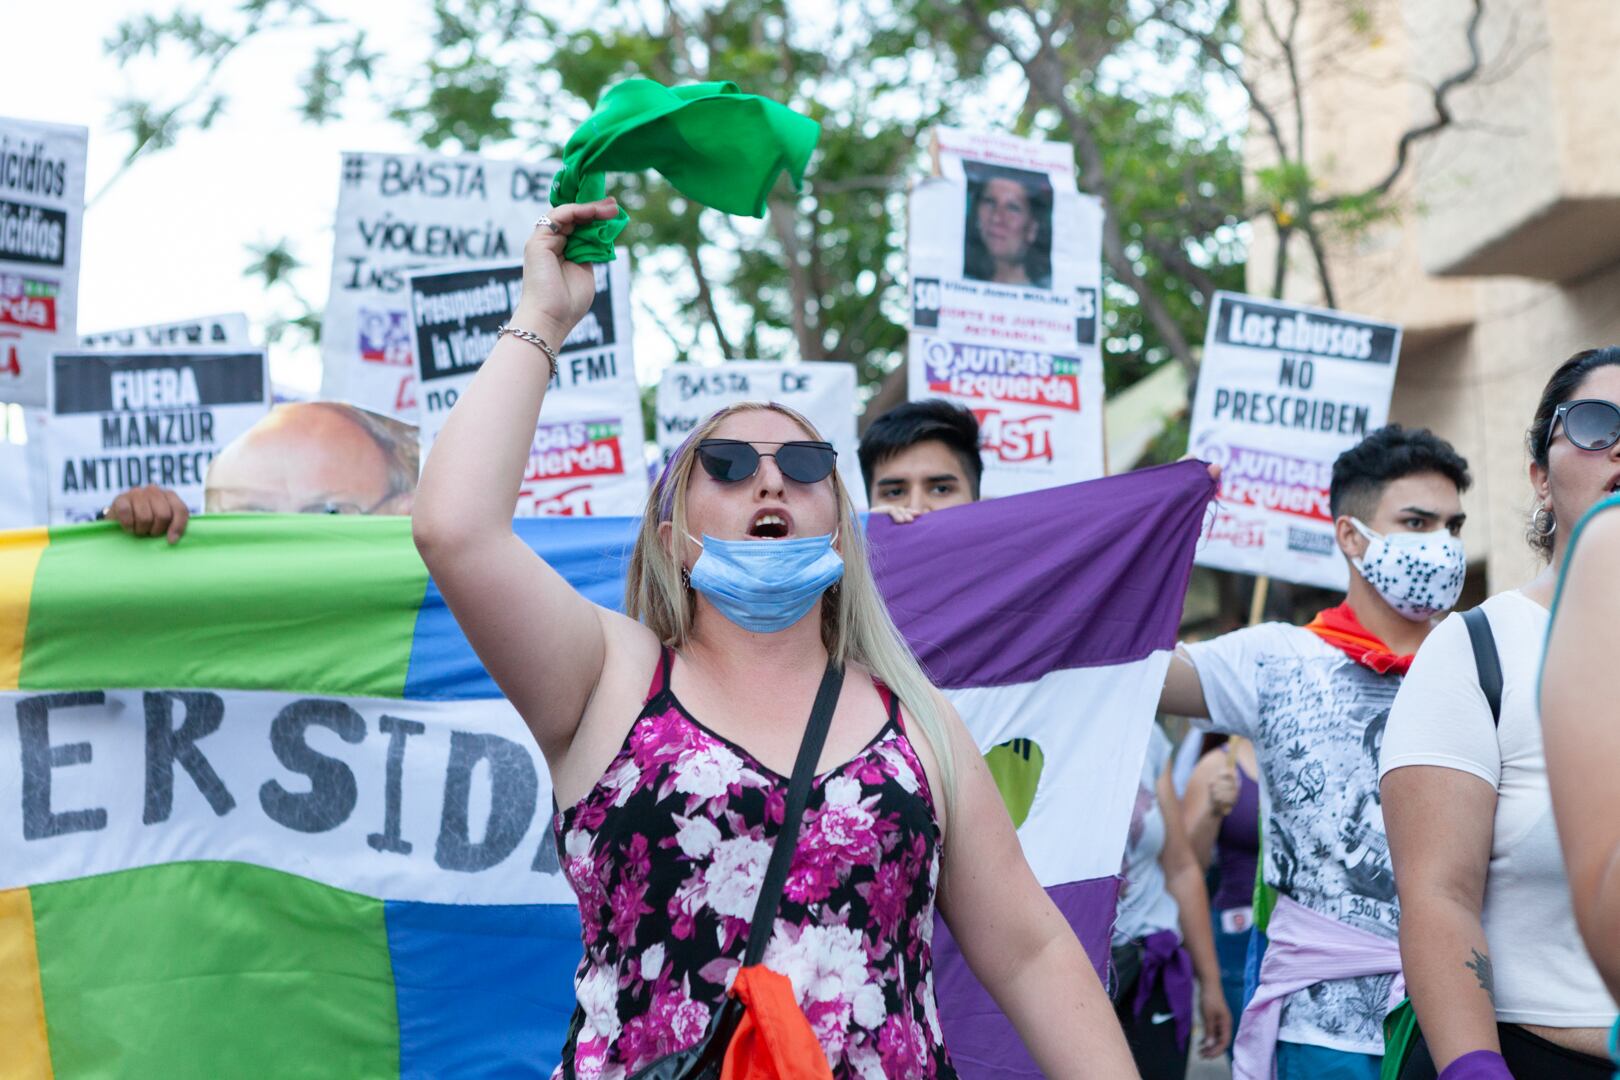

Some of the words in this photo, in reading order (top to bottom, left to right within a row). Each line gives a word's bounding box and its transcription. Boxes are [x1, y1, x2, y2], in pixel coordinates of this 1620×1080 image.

[380, 158, 486, 200] BASTA
[511, 168, 552, 203] DE
[344, 257, 425, 291] INS
[1228, 303, 1275, 348] Los
[1277, 312, 1373, 360] abusos
[111, 366, 200, 412] FUERA
[570, 352, 617, 386] FMI
[677, 373, 749, 400] BASTA
[781, 371, 811, 392] DE
[1278, 357, 1314, 391] NO
[102, 411, 214, 449] MANZUR
[1213, 389, 1370, 436] PRESCRIBEN
[63, 450, 213, 493] ANTIDEREC
[15, 690, 560, 876] ERSID
[1348, 897, 1381, 920] Bob
